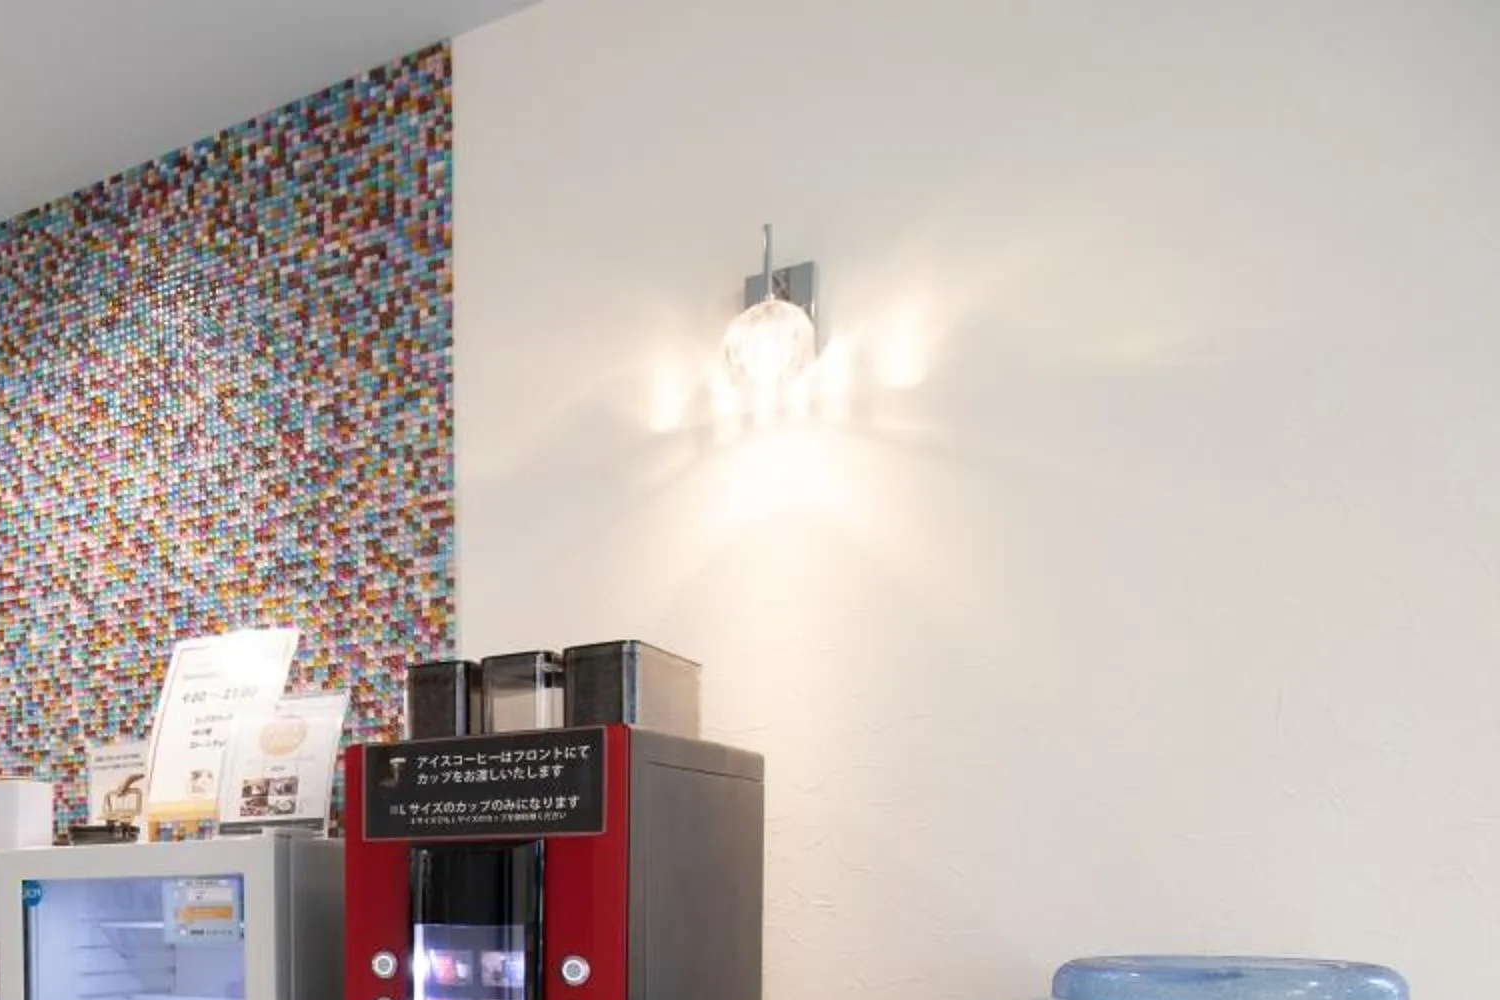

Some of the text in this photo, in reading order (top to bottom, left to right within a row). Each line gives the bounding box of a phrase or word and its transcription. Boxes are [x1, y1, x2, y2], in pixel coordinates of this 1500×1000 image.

[416, 745, 590, 769] アイスコーヒーはフロントにて
[417, 765, 564, 784] カップをお渡しいたします
